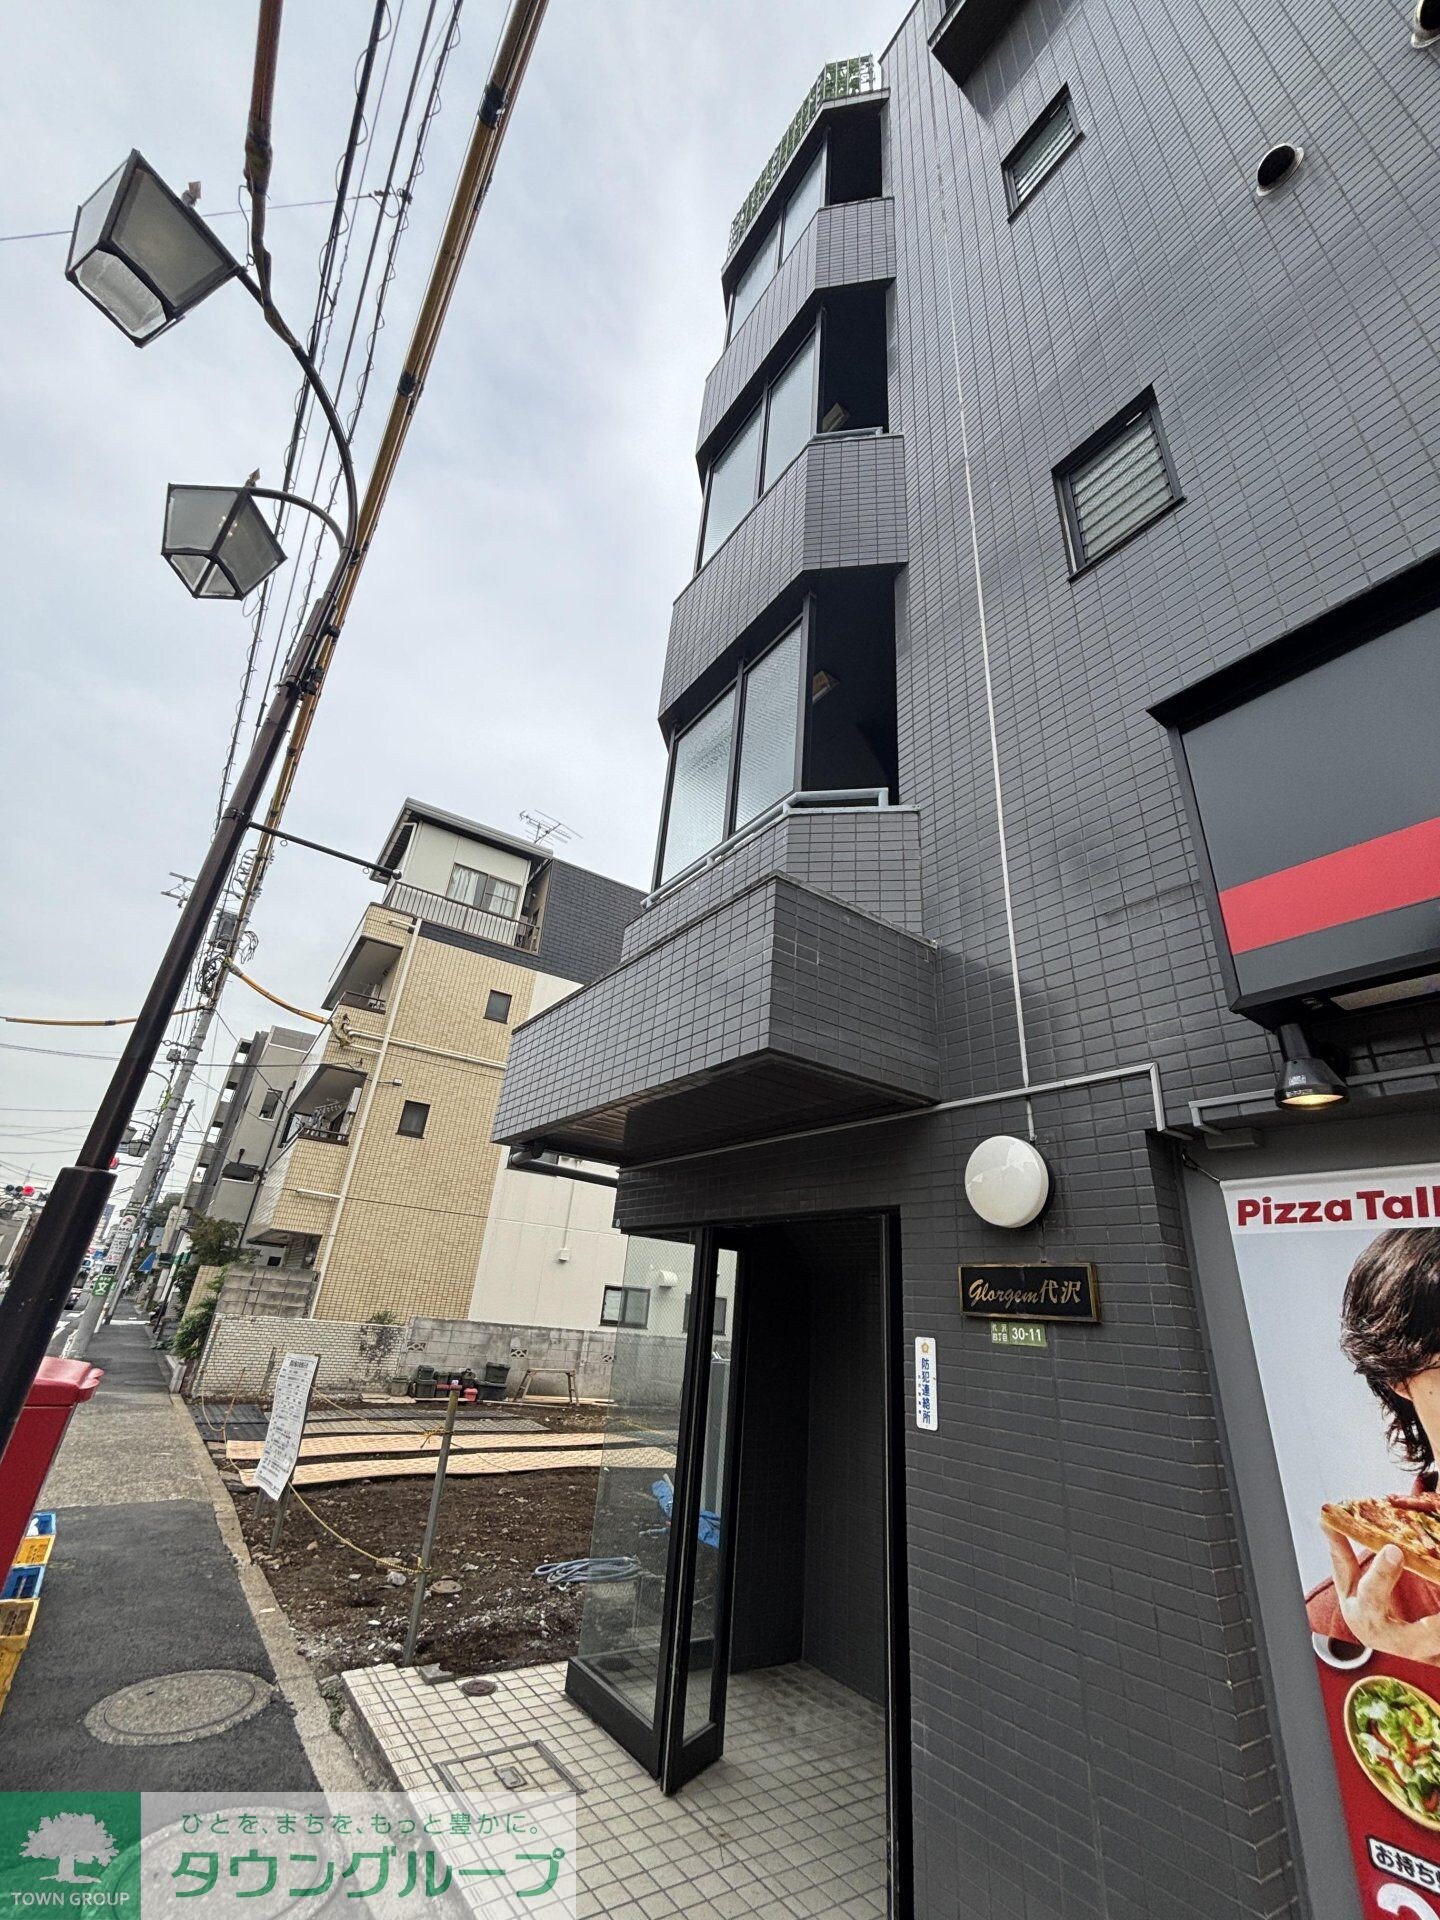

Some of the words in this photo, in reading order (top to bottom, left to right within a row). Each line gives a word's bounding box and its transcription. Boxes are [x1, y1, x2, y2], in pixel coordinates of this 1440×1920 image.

[1237, 1196, 1352, 1226] Pizza
[1011, 1327, 1041, 1342] 30-11
[921, 1357, 931, 1425] 防犯連絡所
[1375, 1844, 1440, 1889] お持ち
